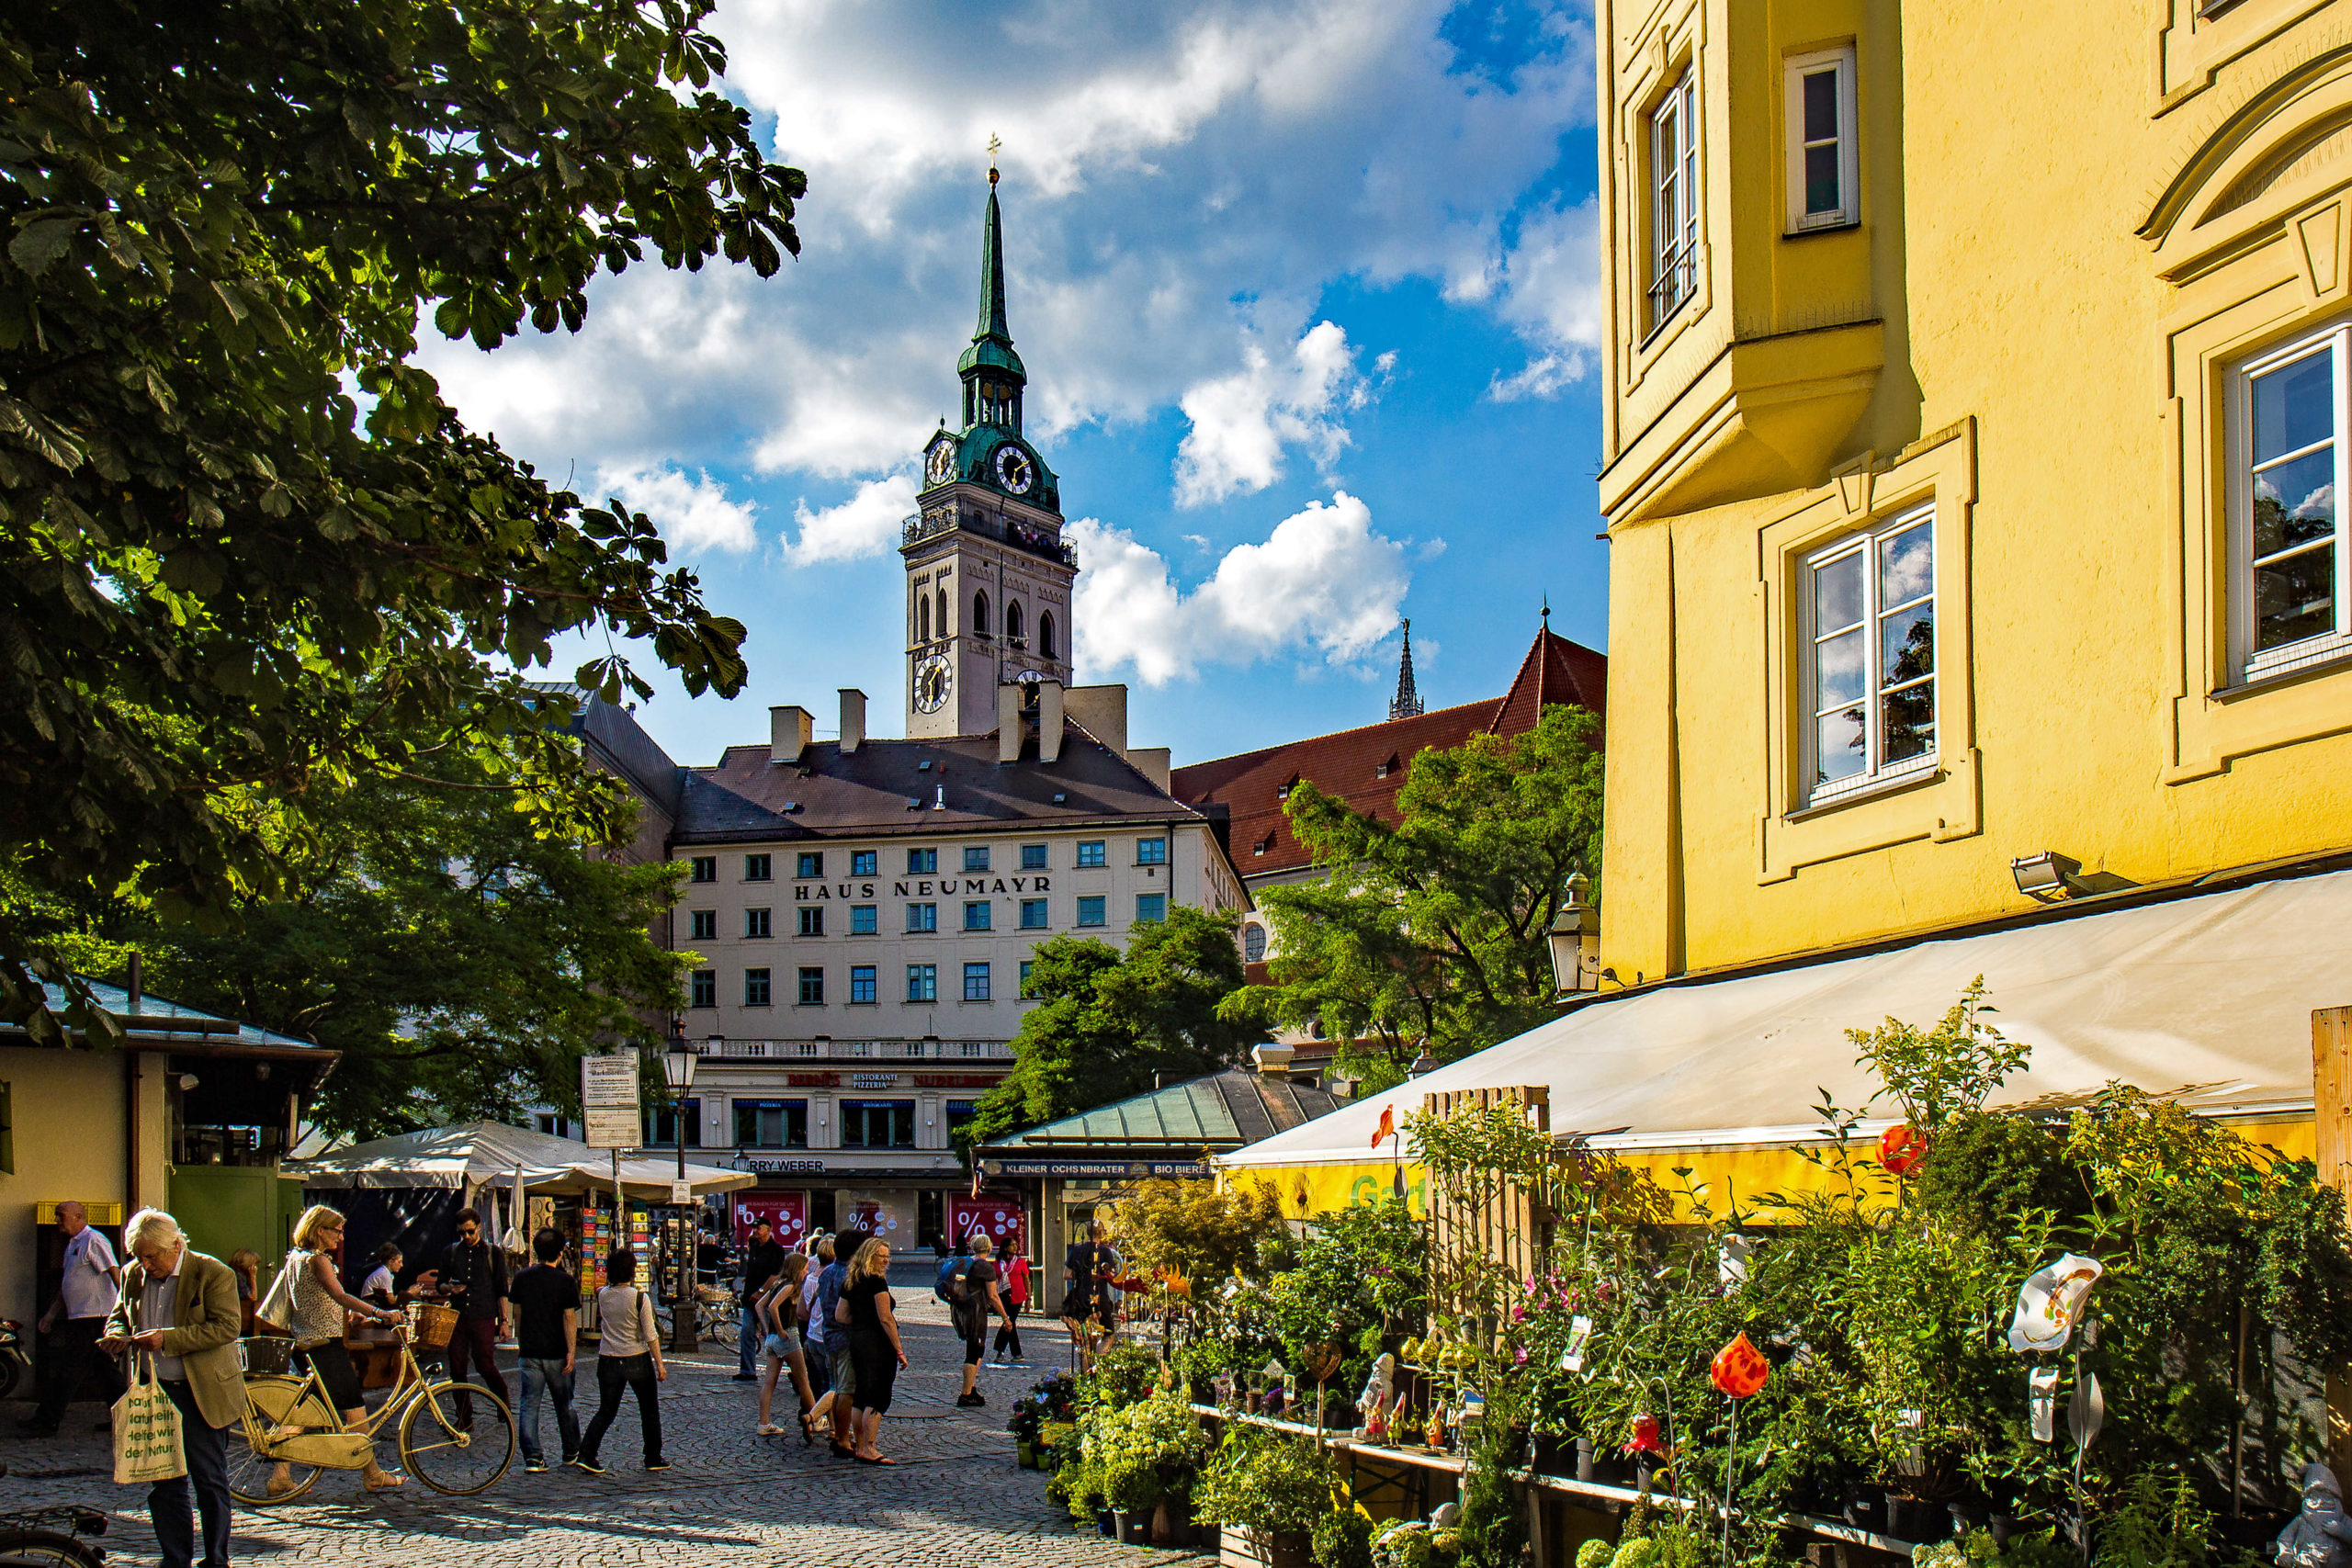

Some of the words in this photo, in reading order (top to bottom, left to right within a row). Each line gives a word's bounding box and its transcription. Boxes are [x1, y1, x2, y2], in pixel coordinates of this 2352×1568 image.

[795, 883, 875, 900] HAUS
[894, 876, 1051, 897] NEUMAYR
[853, 1073, 899, 1081] RISTORANTE
[732, 1159, 775, 1171] RRY
[777, 1160, 825, 1171] WEBER
[1006, 1165, 1047, 1174] KLEINER
[1052, 1165, 1125, 1174] OCHSNBRATER
[1155, 1165, 1173, 1174] BIO
[1175, 1165, 1206, 1174] BIERE
[157, 1426, 175, 1438] wir
[125, 1446, 143, 1459] der
